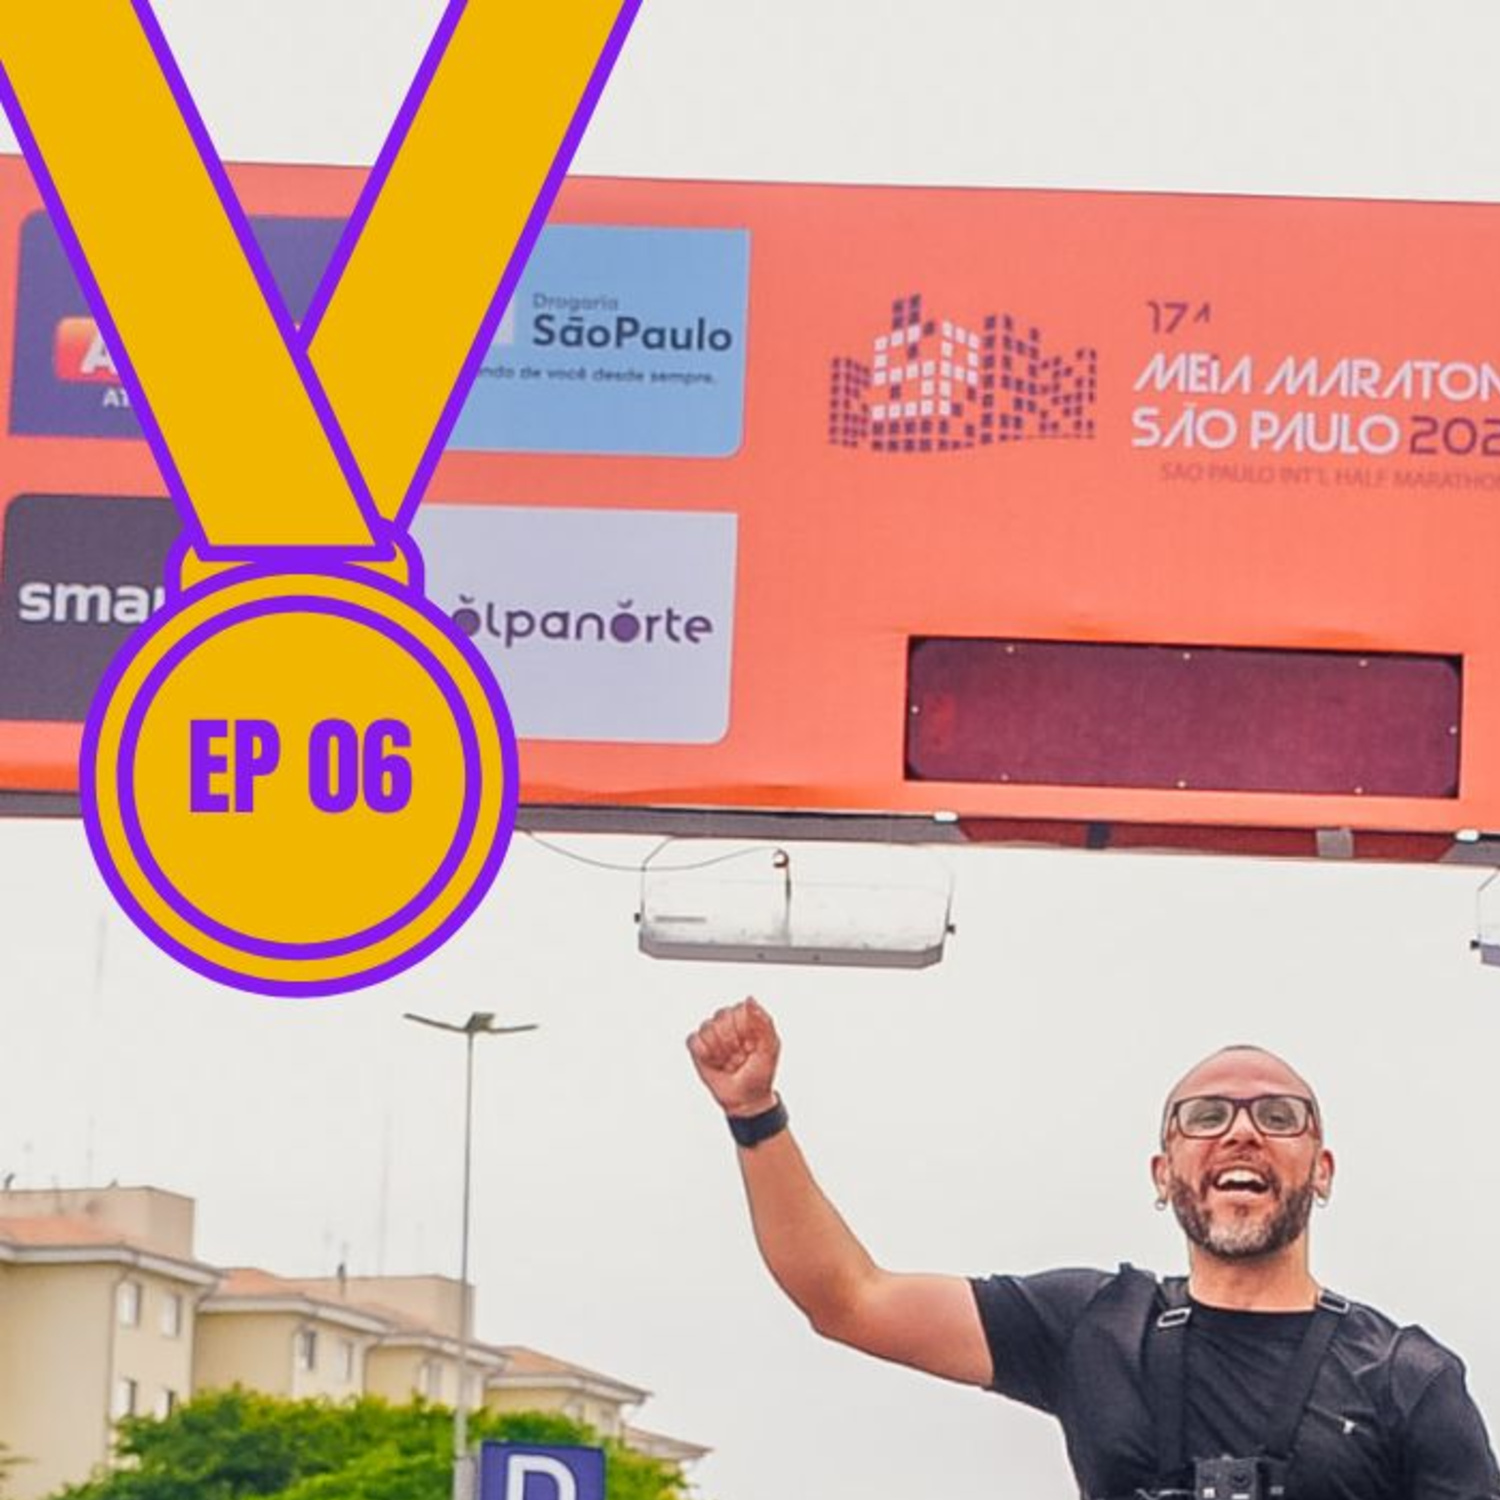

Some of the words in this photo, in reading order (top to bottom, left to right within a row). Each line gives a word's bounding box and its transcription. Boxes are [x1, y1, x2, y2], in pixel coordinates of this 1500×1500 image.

[532, 292, 619, 312] Drogaria
[1131, 402, 1238, 450] SÃO
[1249, 410, 1401, 456] PAULO
[1206, 464, 1276, 487] PAULO
[1334, 468, 1388, 489] HALF
